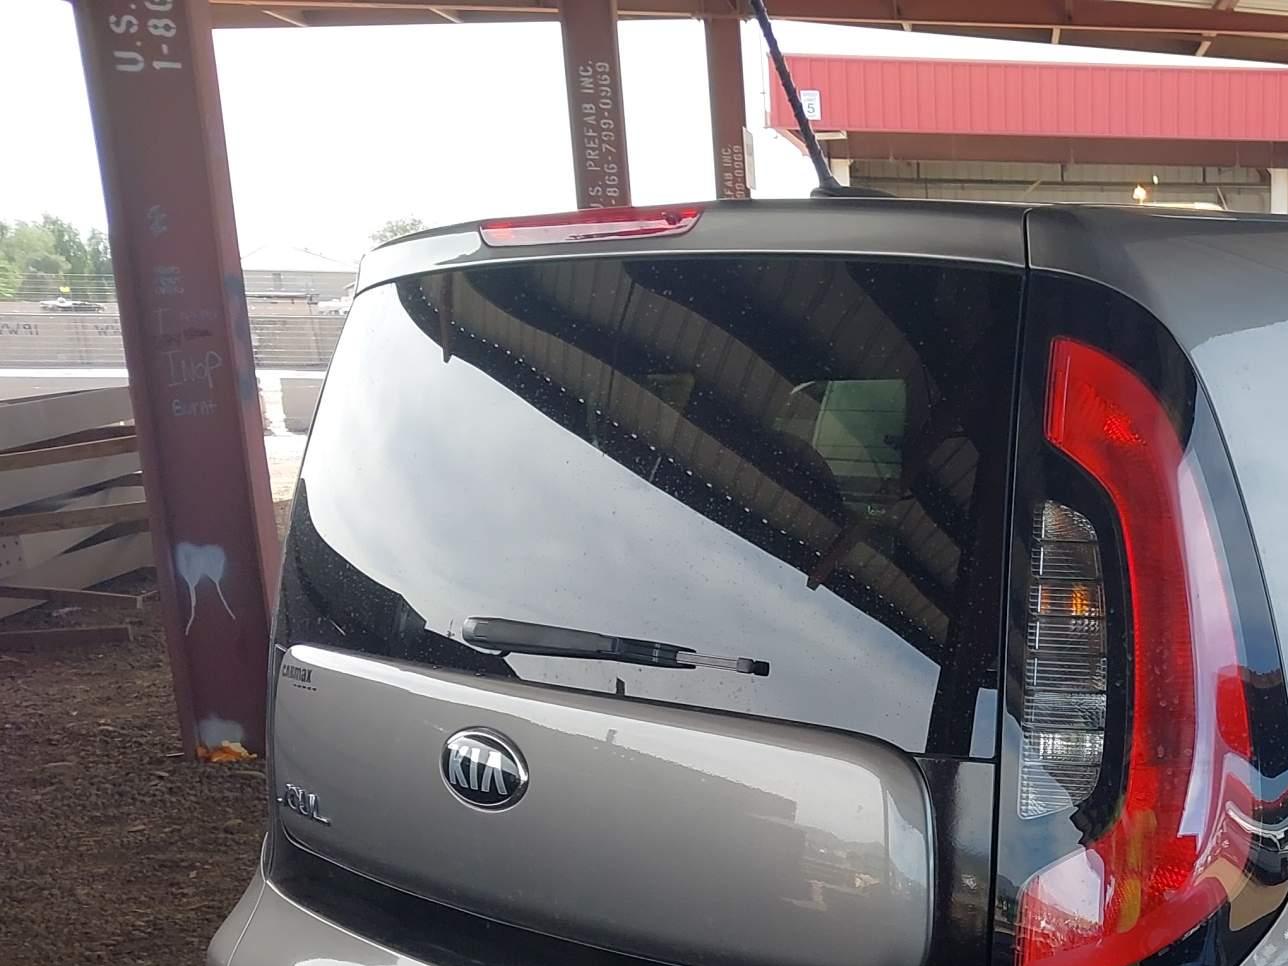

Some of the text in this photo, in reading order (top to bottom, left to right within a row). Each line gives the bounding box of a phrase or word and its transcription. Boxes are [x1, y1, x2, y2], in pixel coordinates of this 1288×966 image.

[108, 2, 145, 73] U.S.
[578, 60, 596, 93] INC.
[806, 103, 815, 114] 5
[582, 103, 601, 170] PREFAB
[446, 743, 509, 796] KIA
